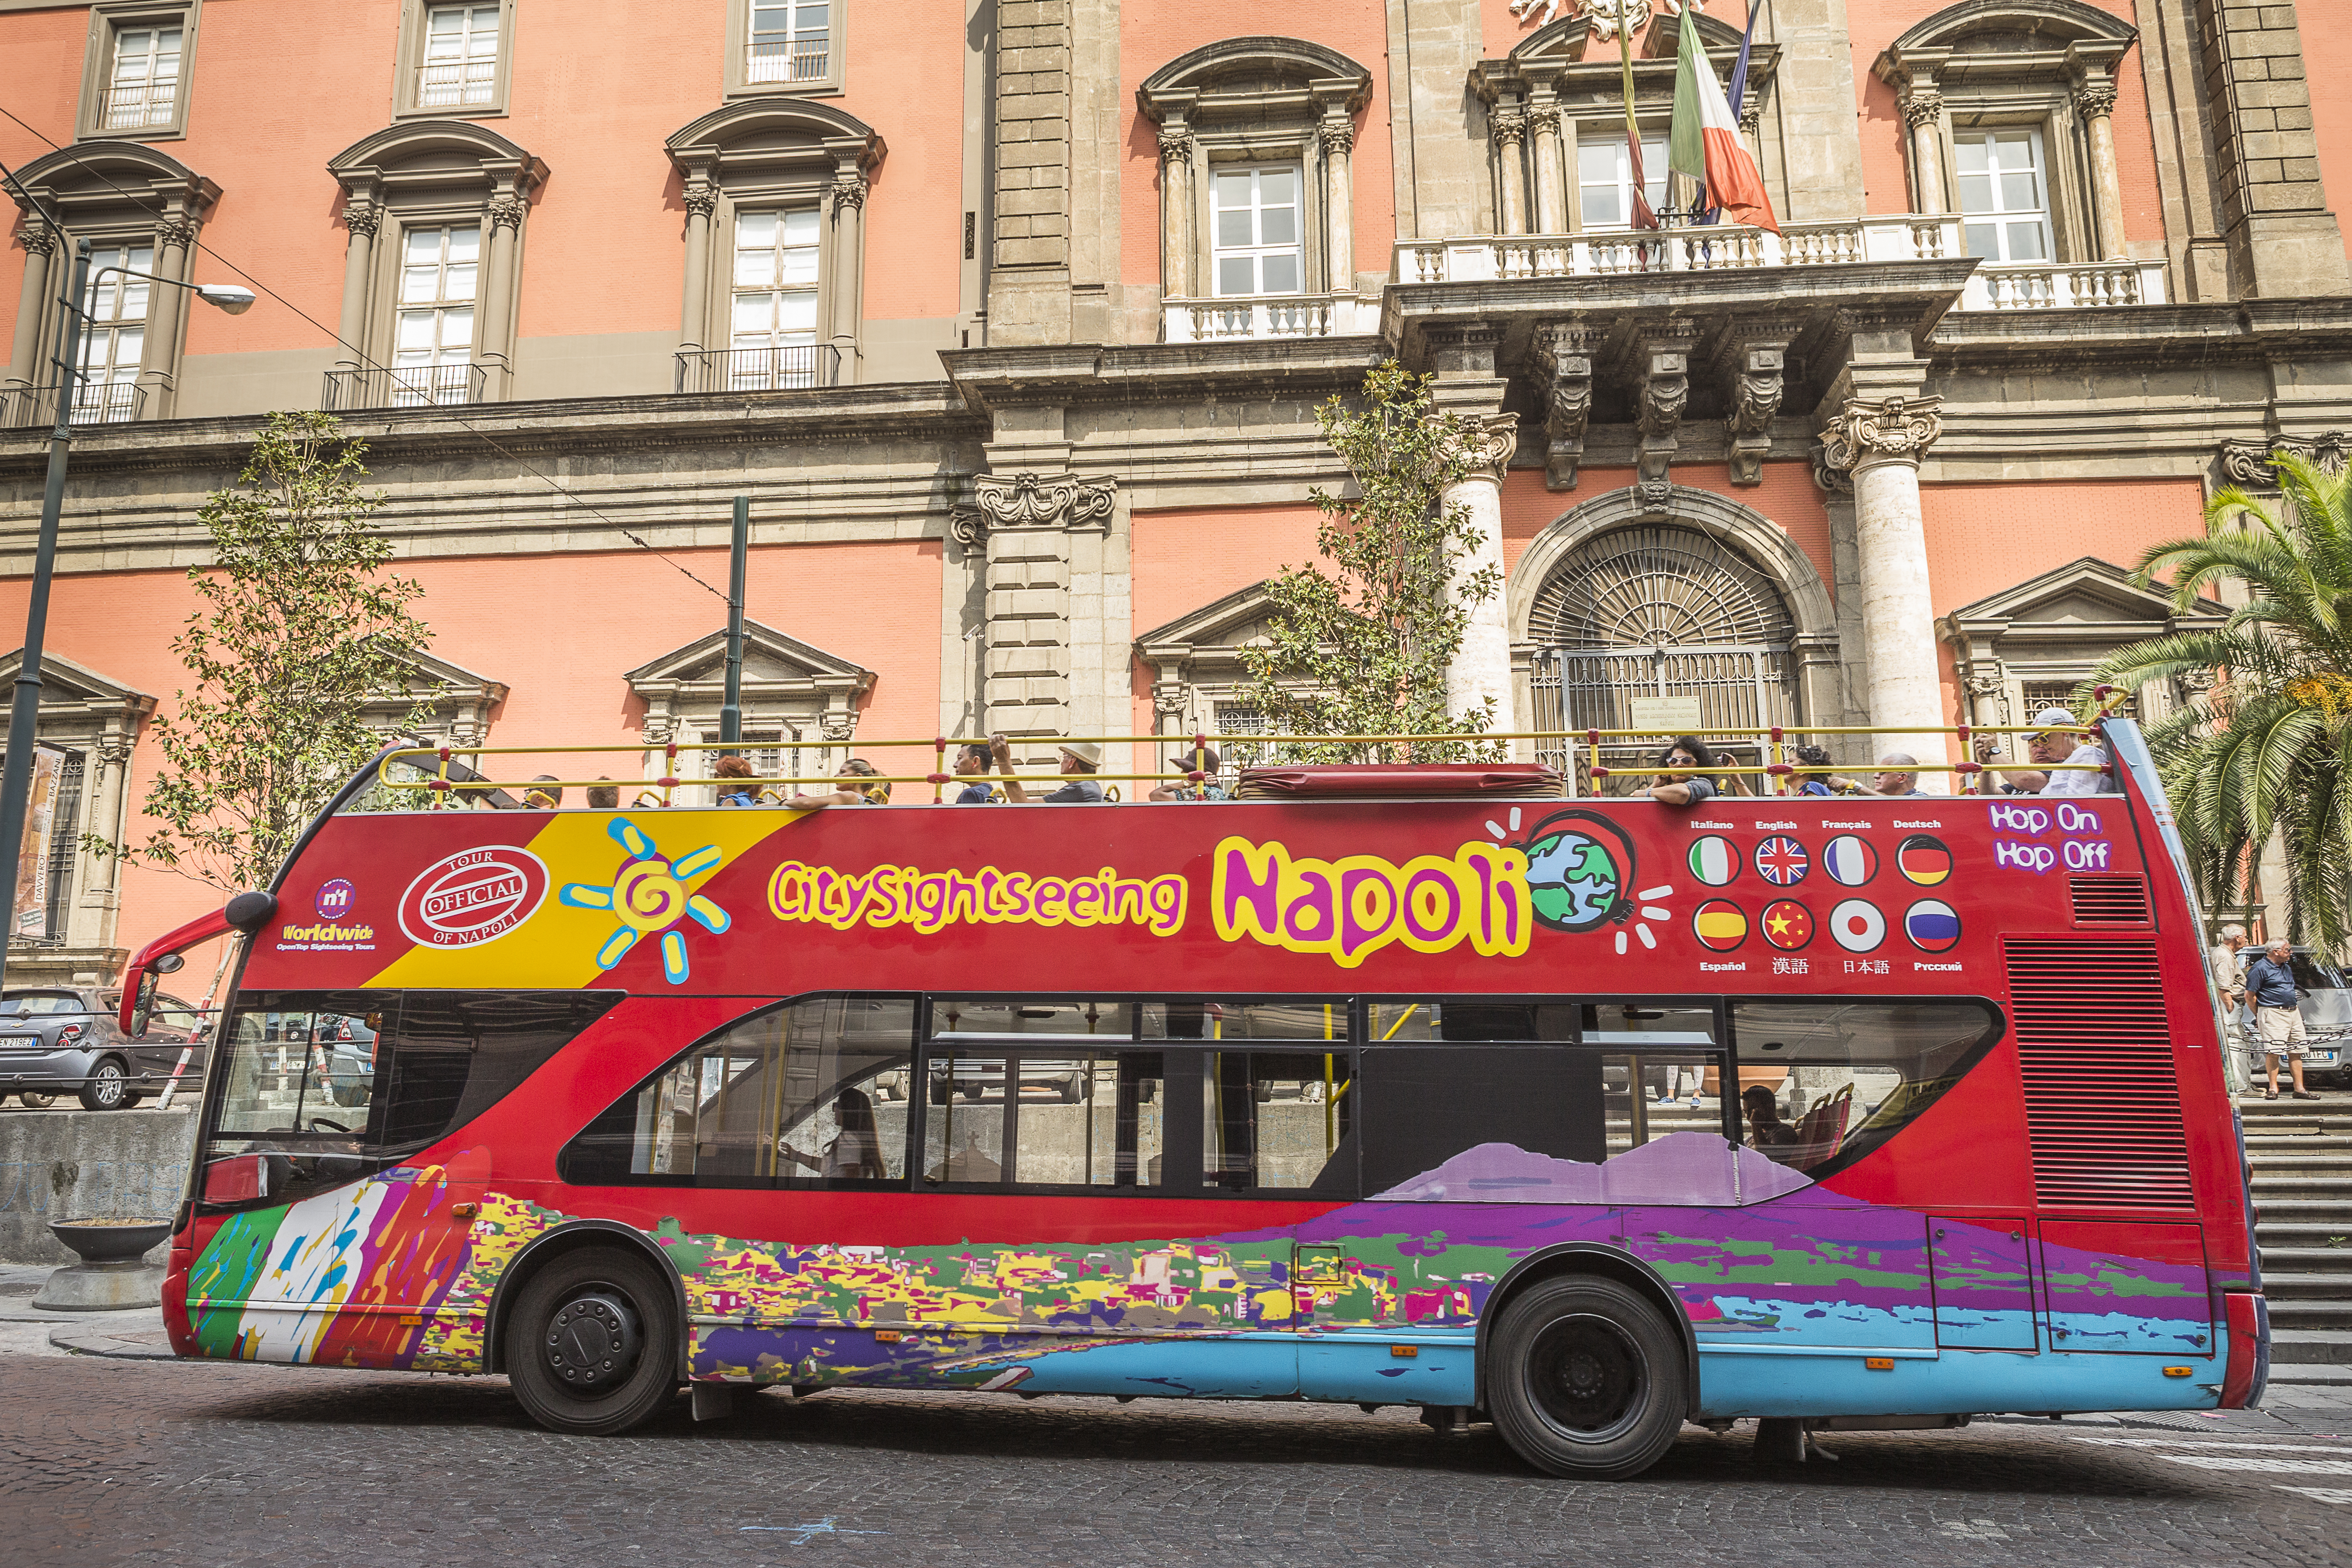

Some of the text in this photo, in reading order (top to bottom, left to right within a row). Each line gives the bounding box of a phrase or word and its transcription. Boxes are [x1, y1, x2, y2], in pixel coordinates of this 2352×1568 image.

[46, 758, 61, 813] Luigi BAZZANI
[1690, 821, 1734, 829] Italiano
[1755, 821, 1798, 831] English
[1821, 820, 1872, 830] Français
[1893, 820, 1941, 828] Deutsch
[1990, 803, 2098, 834] Hop On
[447, 851, 494, 871] TOUR
[1996, 840, 2109, 872] Hop Off
[36, 854, 46, 900] DAVVERO!
[427, 878, 521, 914] OFFICIAL
[1211, 836, 1532, 968] Napoli
[282, 923, 373, 941] Worldwide
[433, 912, 519, 944] OF NAPOLI
[1699, 962, 1746, 972] Español
[1772, 957, 1809, 975] 漢語
[1843, 959, 1890, 974] 日本語
[10, 1038, 32, 1046] 219EZ
